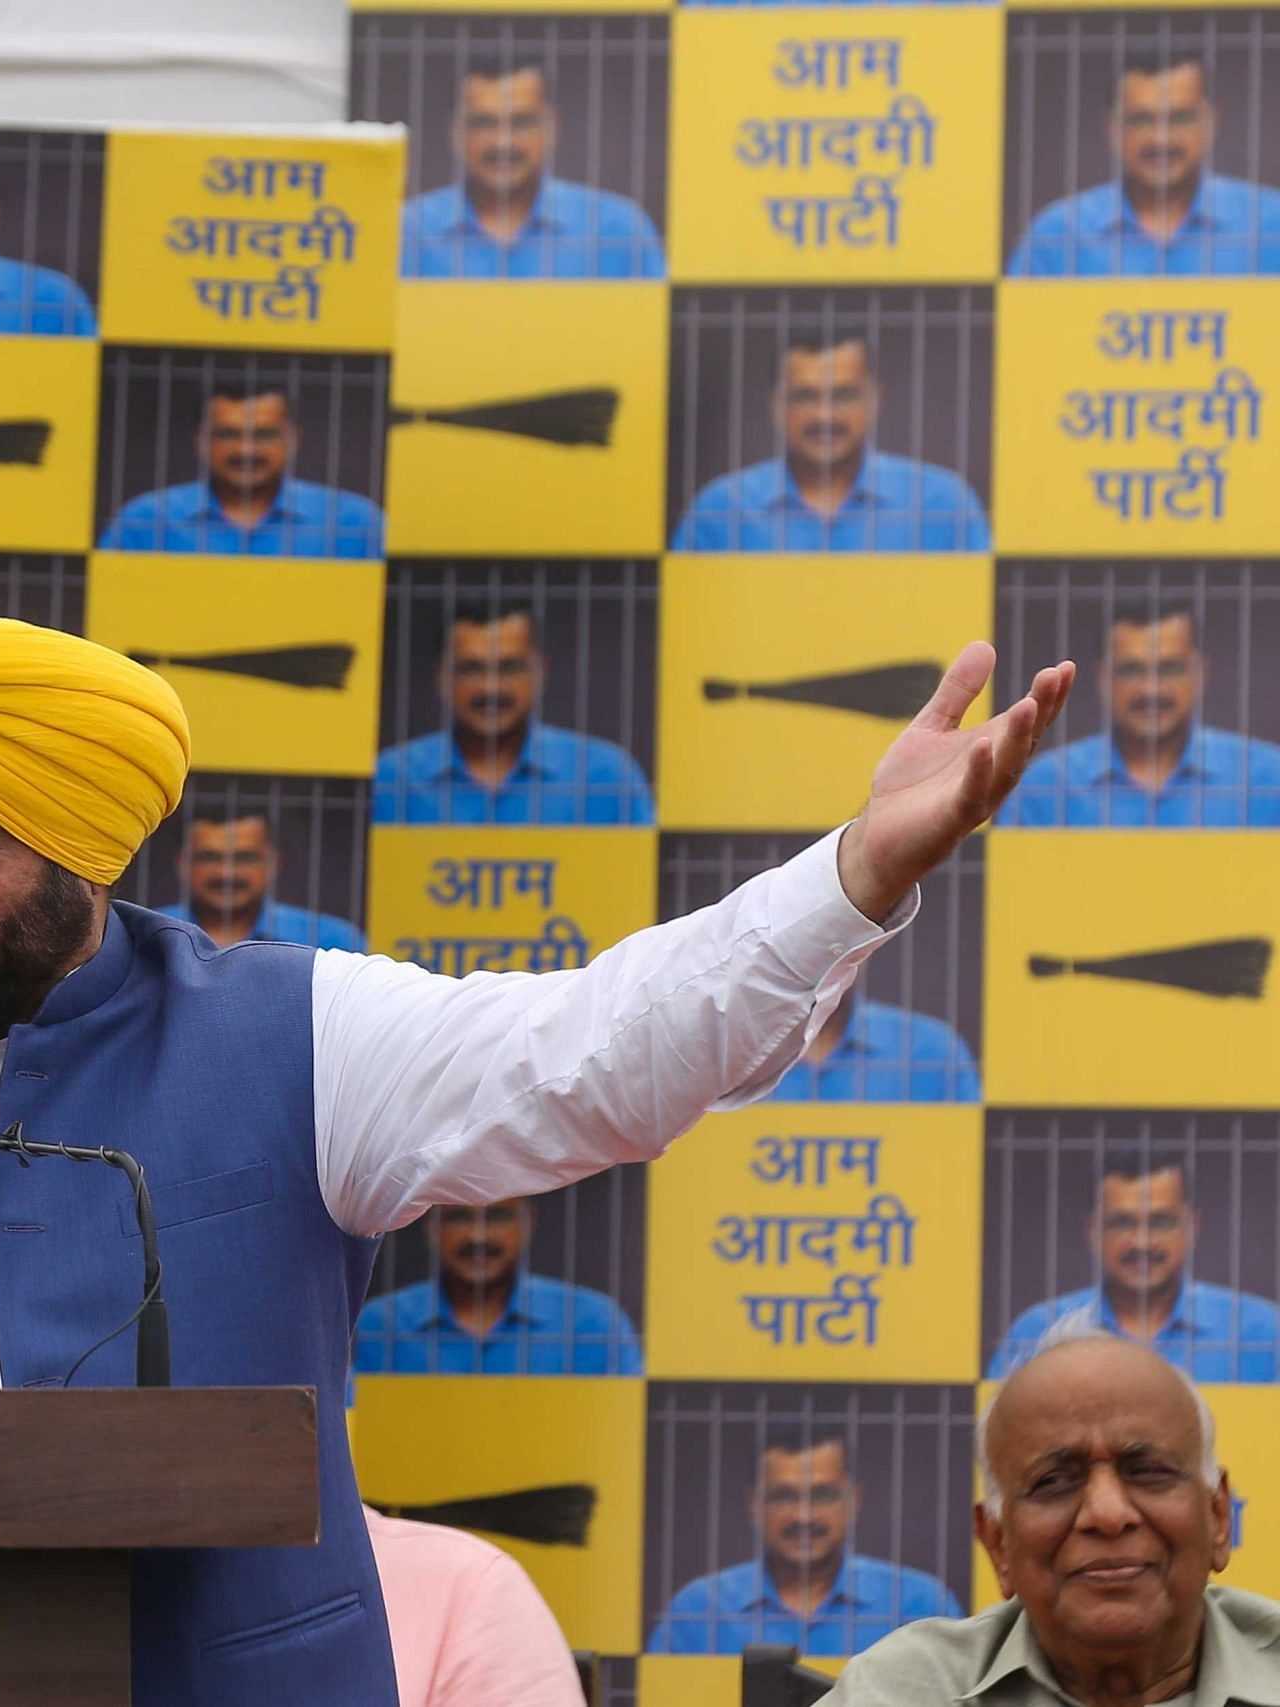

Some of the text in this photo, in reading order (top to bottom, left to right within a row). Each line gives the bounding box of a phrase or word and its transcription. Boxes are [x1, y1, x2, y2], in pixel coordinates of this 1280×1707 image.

[775, 38, 902, 90] आम
[736, 96, 937, 169] आदमी
[205, 158, 326, 200] आम
[167, 205, 357, 262] आदमी
[765, 173, 901, 248] पार्टी
[194, 265, 322, 322] पार्टी
[1099, 311, 1228, 361] आम
[1061, 367, 1263, 442] आदमी
[1090, 446, 1227, 521] पार्टी
[427, 858, 557, 908] आम
[750, 1136, 883, 1187] आम
[714, 1194, 917, 1268] आदमी
[740, 1273, 882, 1347] पार्टी
